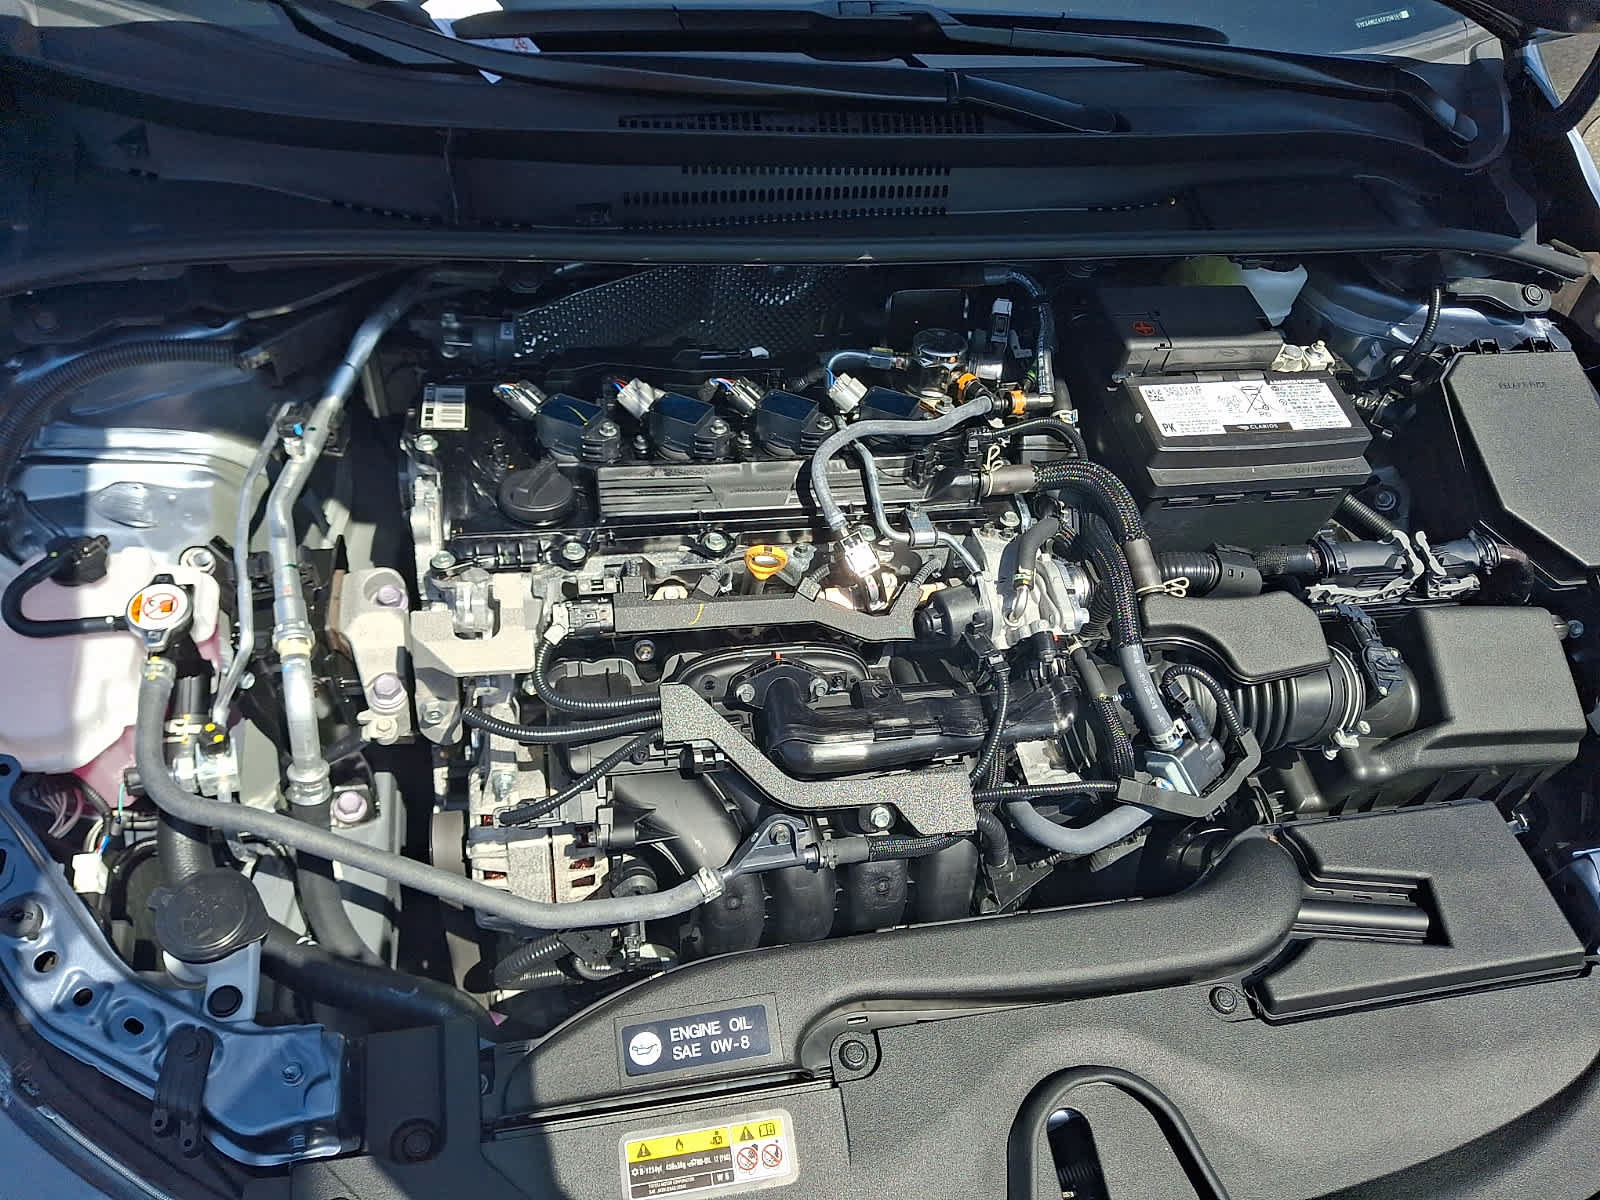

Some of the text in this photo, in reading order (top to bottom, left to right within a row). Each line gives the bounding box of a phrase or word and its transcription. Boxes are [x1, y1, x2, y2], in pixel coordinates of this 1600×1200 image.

[1161, 423, 1177, 433] PK
[670, 1016, 753, 1042] ENGINE OIL
[672, 1035, 751, 1061] SAE 0W-8
